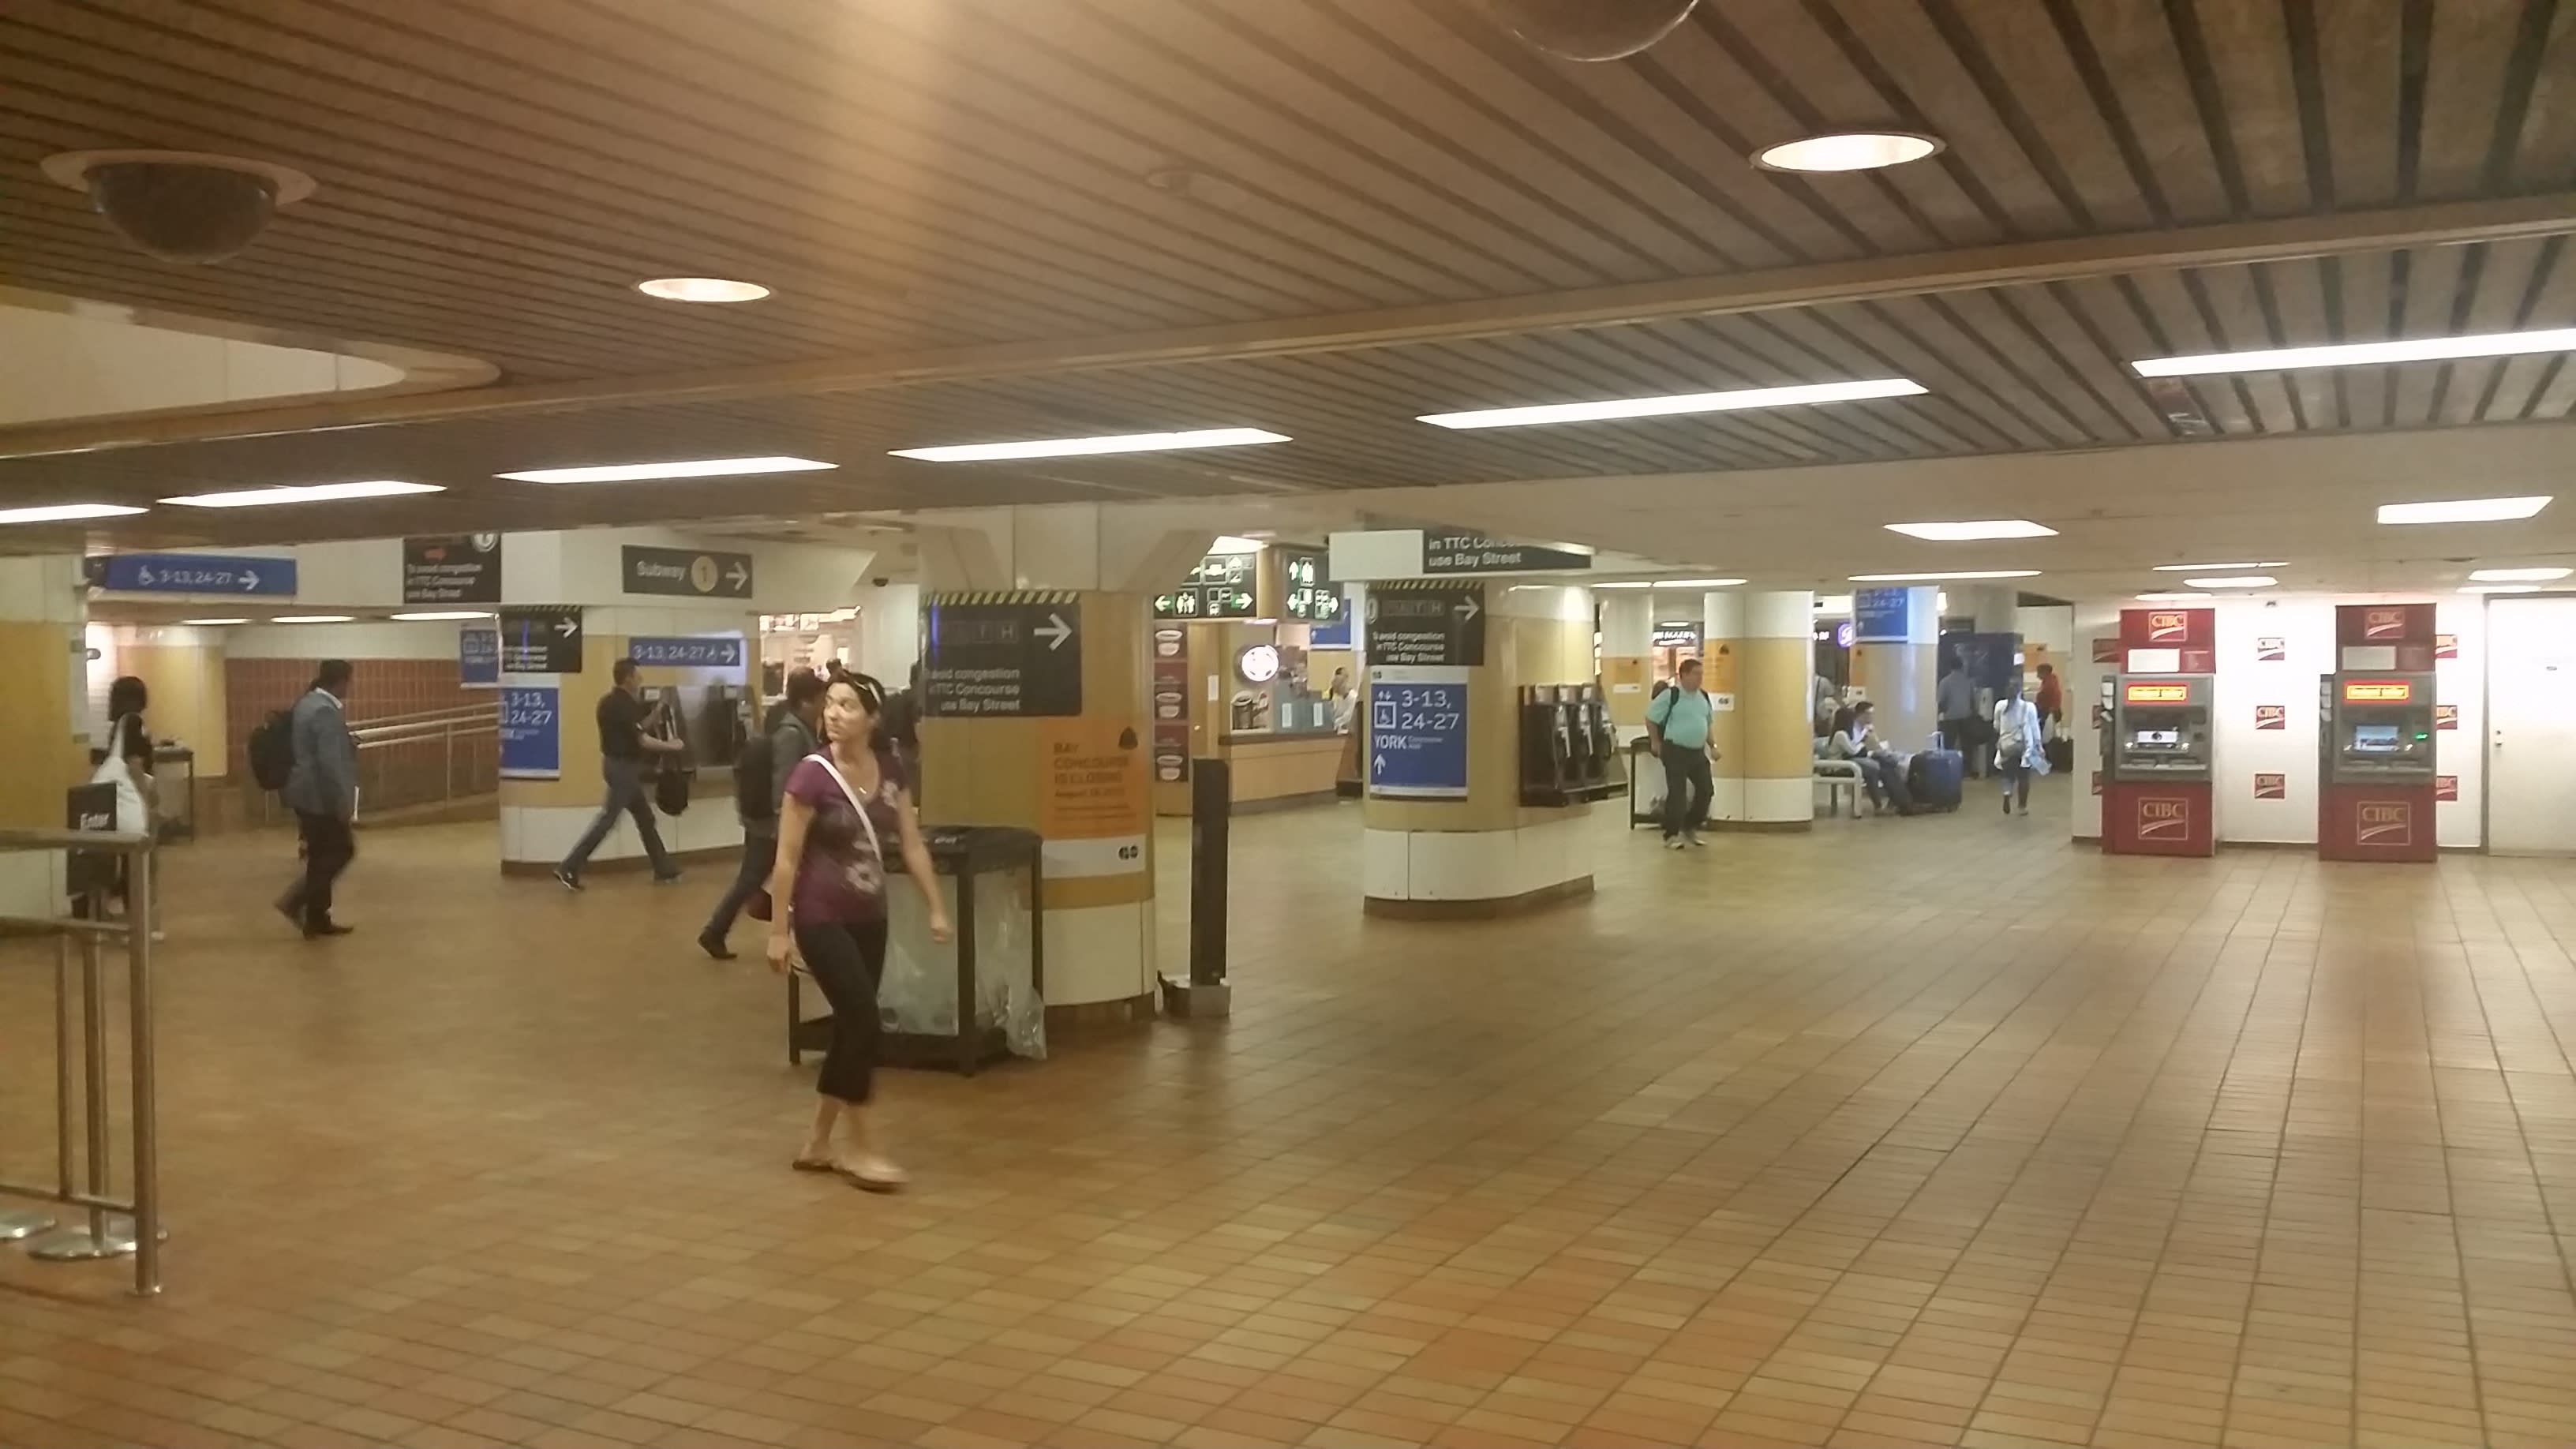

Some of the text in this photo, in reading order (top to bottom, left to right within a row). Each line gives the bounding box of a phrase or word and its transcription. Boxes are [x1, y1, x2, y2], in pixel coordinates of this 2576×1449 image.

[1429, 539, 1441, 550] in
[1444, 537, 1470, 549] TTC
[1429, 552, 1522, 567] use Bay Street
[637, 560, 686, 581] Subway
[2151, 615, 2183, 628] CIBC
[2368, 612, 2402, 624] CIBC
[1397, 632, 1446, 642] congestion
[1398, 642, 1446, 652] Concourse
[1399, 653, 1417, 665] Bay
[1417, 653, 1446, 663] Street
[954, 669, 1020, 683] congestion
[956, 682, 1020, 695] Concourse
[511, 691, 546, 710] 3-13,
[959, 698, 980, 713] Bay
[983, 698, 1020, 711] Street
[1401, 689, 1452, 710] 3-13,
[511, 710, 552, 725] 24-27
[2256, 706, 2285, 718] CIBC
[1401, 712, 1460, 731] 24-27
[1374, 735, 1408, 750] YORK
[2256, 774, 2284, 786] CIBC
[2143, 803, 2185, 818] CIBC
[2361, 807, 2406, 822] CIBC
